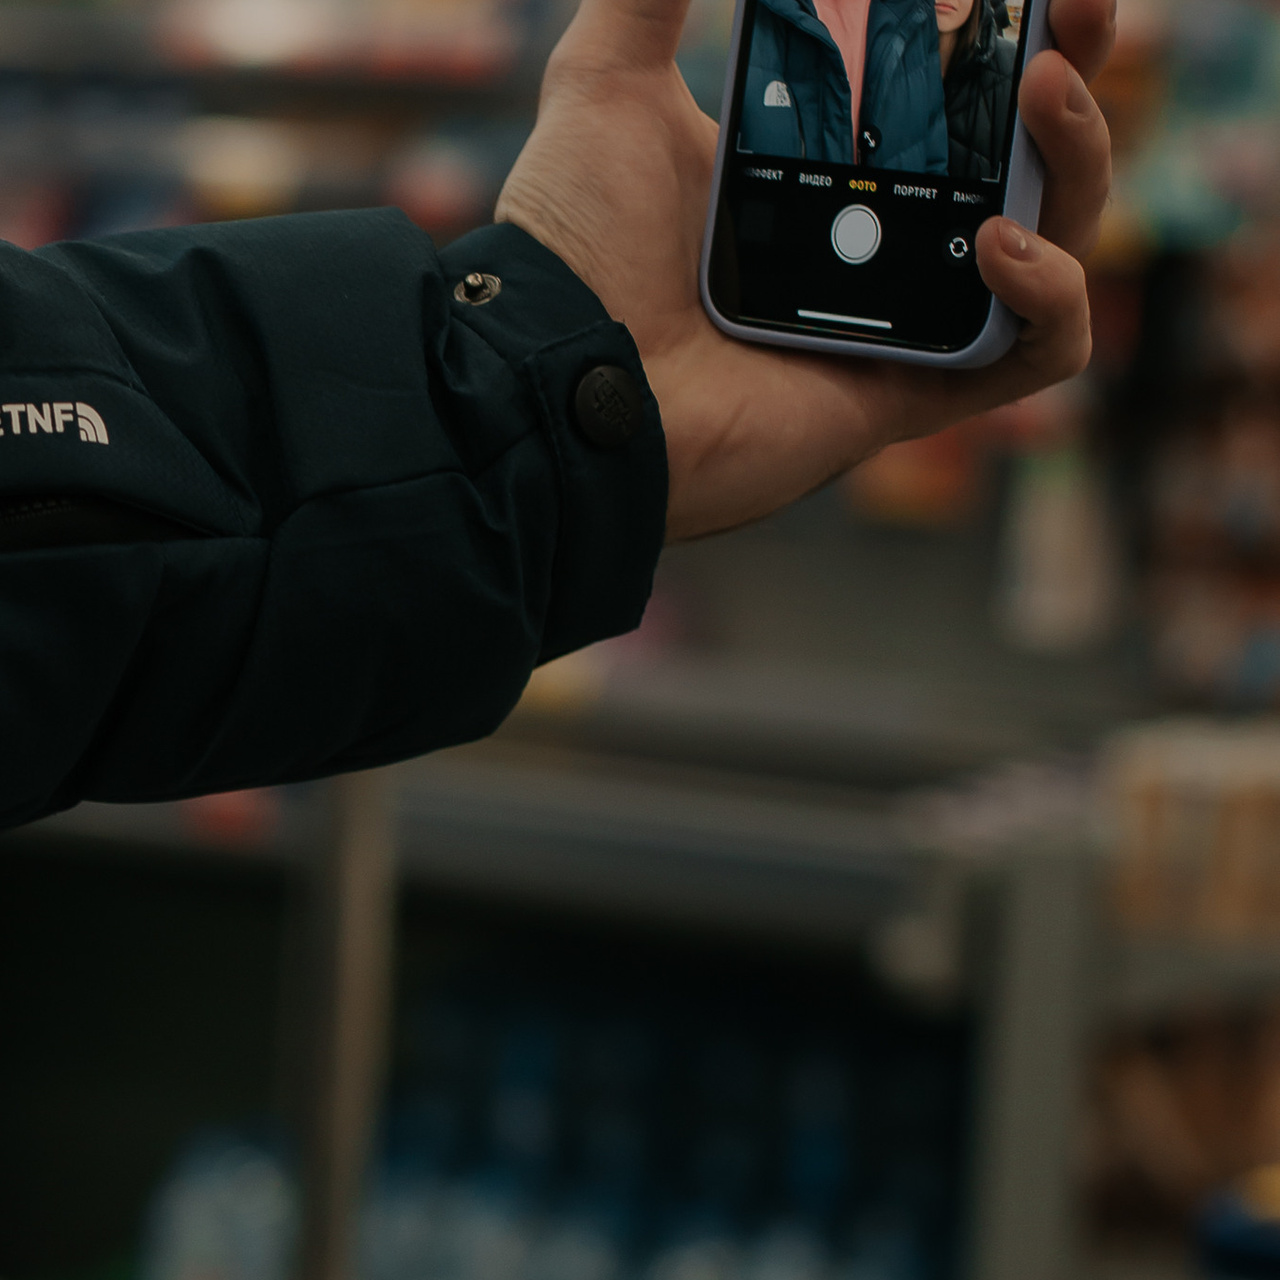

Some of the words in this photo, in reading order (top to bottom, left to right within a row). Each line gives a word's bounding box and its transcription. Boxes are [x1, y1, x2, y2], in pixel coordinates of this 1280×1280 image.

[798, 172, 833, 188] ВИДЕО
[848, 179, 877, 193] ФОТО
[893, 184, 939, 200] ПОРТРЕТ
